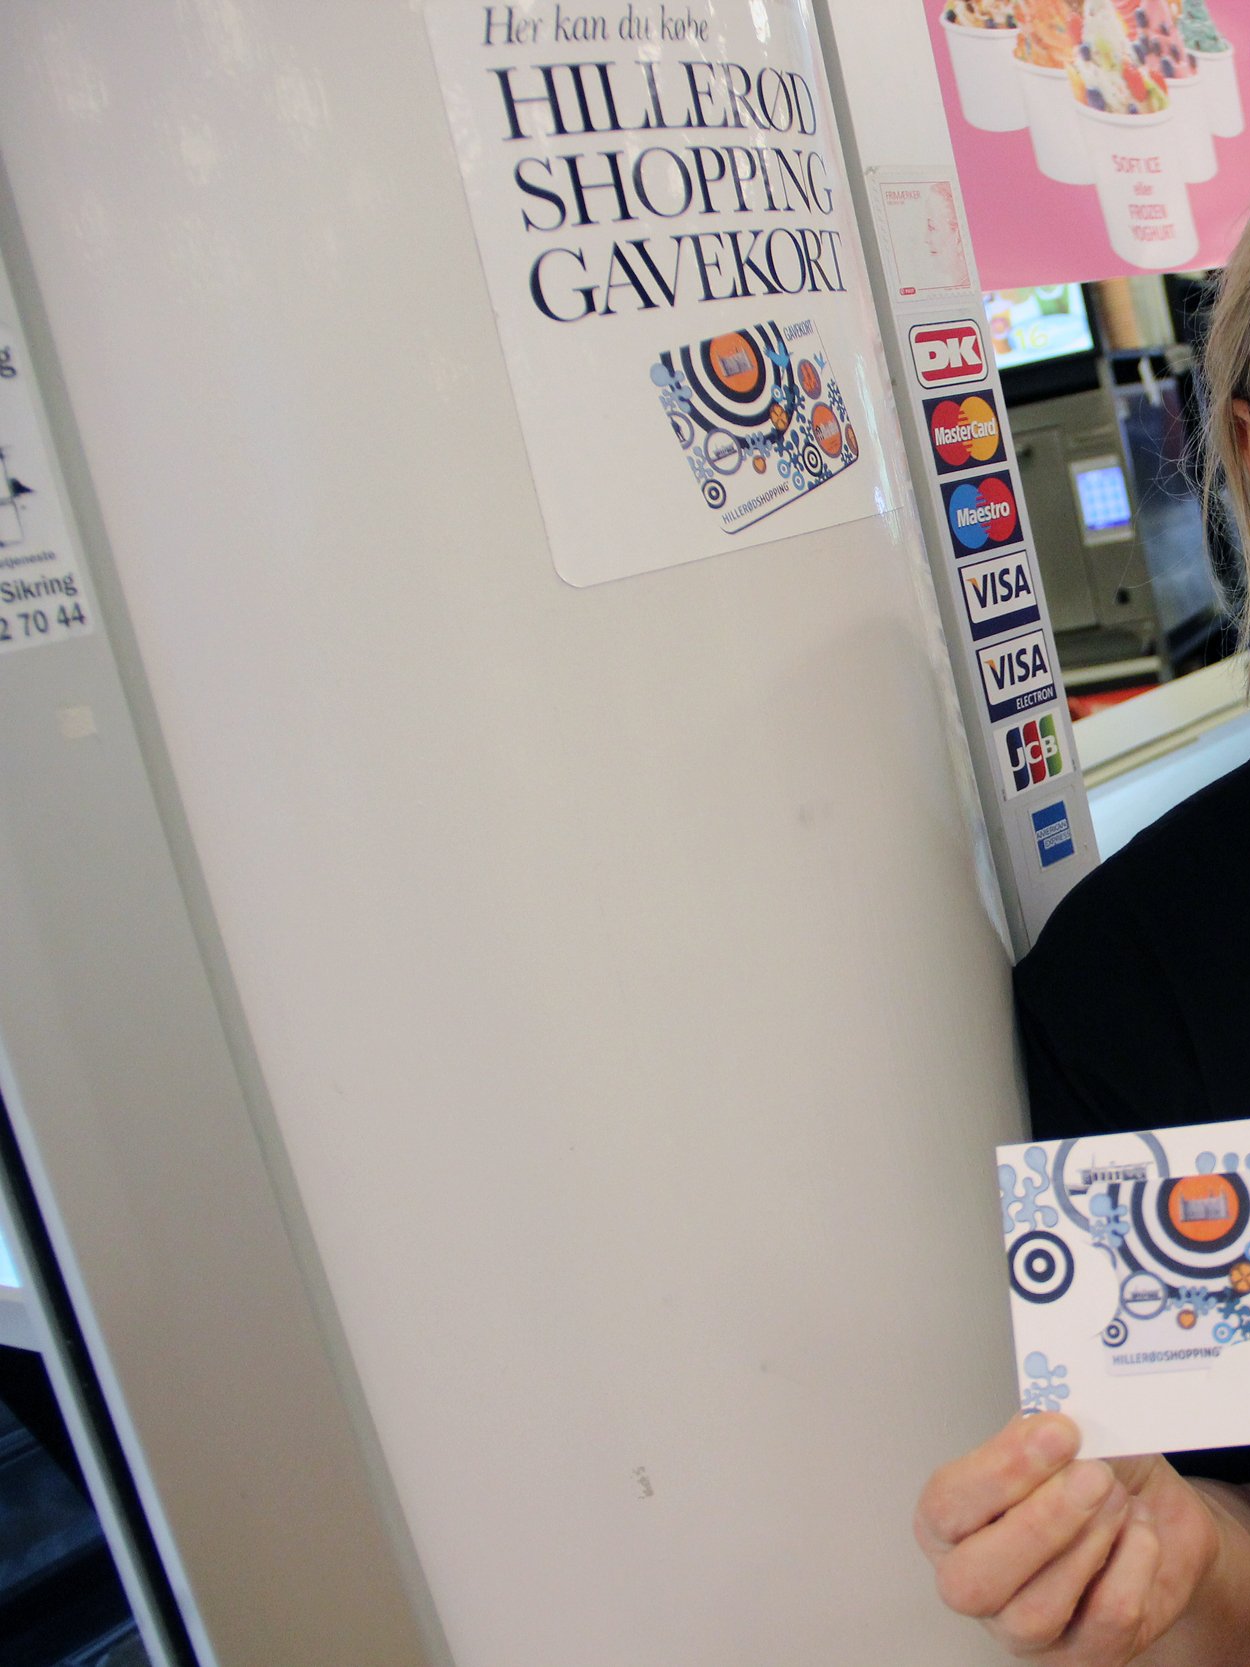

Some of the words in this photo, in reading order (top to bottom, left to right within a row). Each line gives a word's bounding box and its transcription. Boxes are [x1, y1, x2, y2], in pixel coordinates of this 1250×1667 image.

[483, 5, 543, 46] Her
[554, 4, 609, 42] kan
[618, 3, 651, 41] du
[486, 60, 818, 141] HILLERØD
[512, 146, 834, 232] SHOPPING
[529, 228, 847, 323] GAVEKORT
[915, 335, 983, 372] DK
[934, 417, 998, 447] MasterCard
[956, 501, 1011, 528] Maestro
[0, 573, 78, 603] Sikring
[967, 563, 1032, 609] VISA
[17, 609, 49, 636] 70
[57, 602, 86, 628] 44
[984, 643, 1049, 691] VISA
[1016, 685, 1055, 711] ELECTRON
[1011, 735, 1059, 771] JCB
